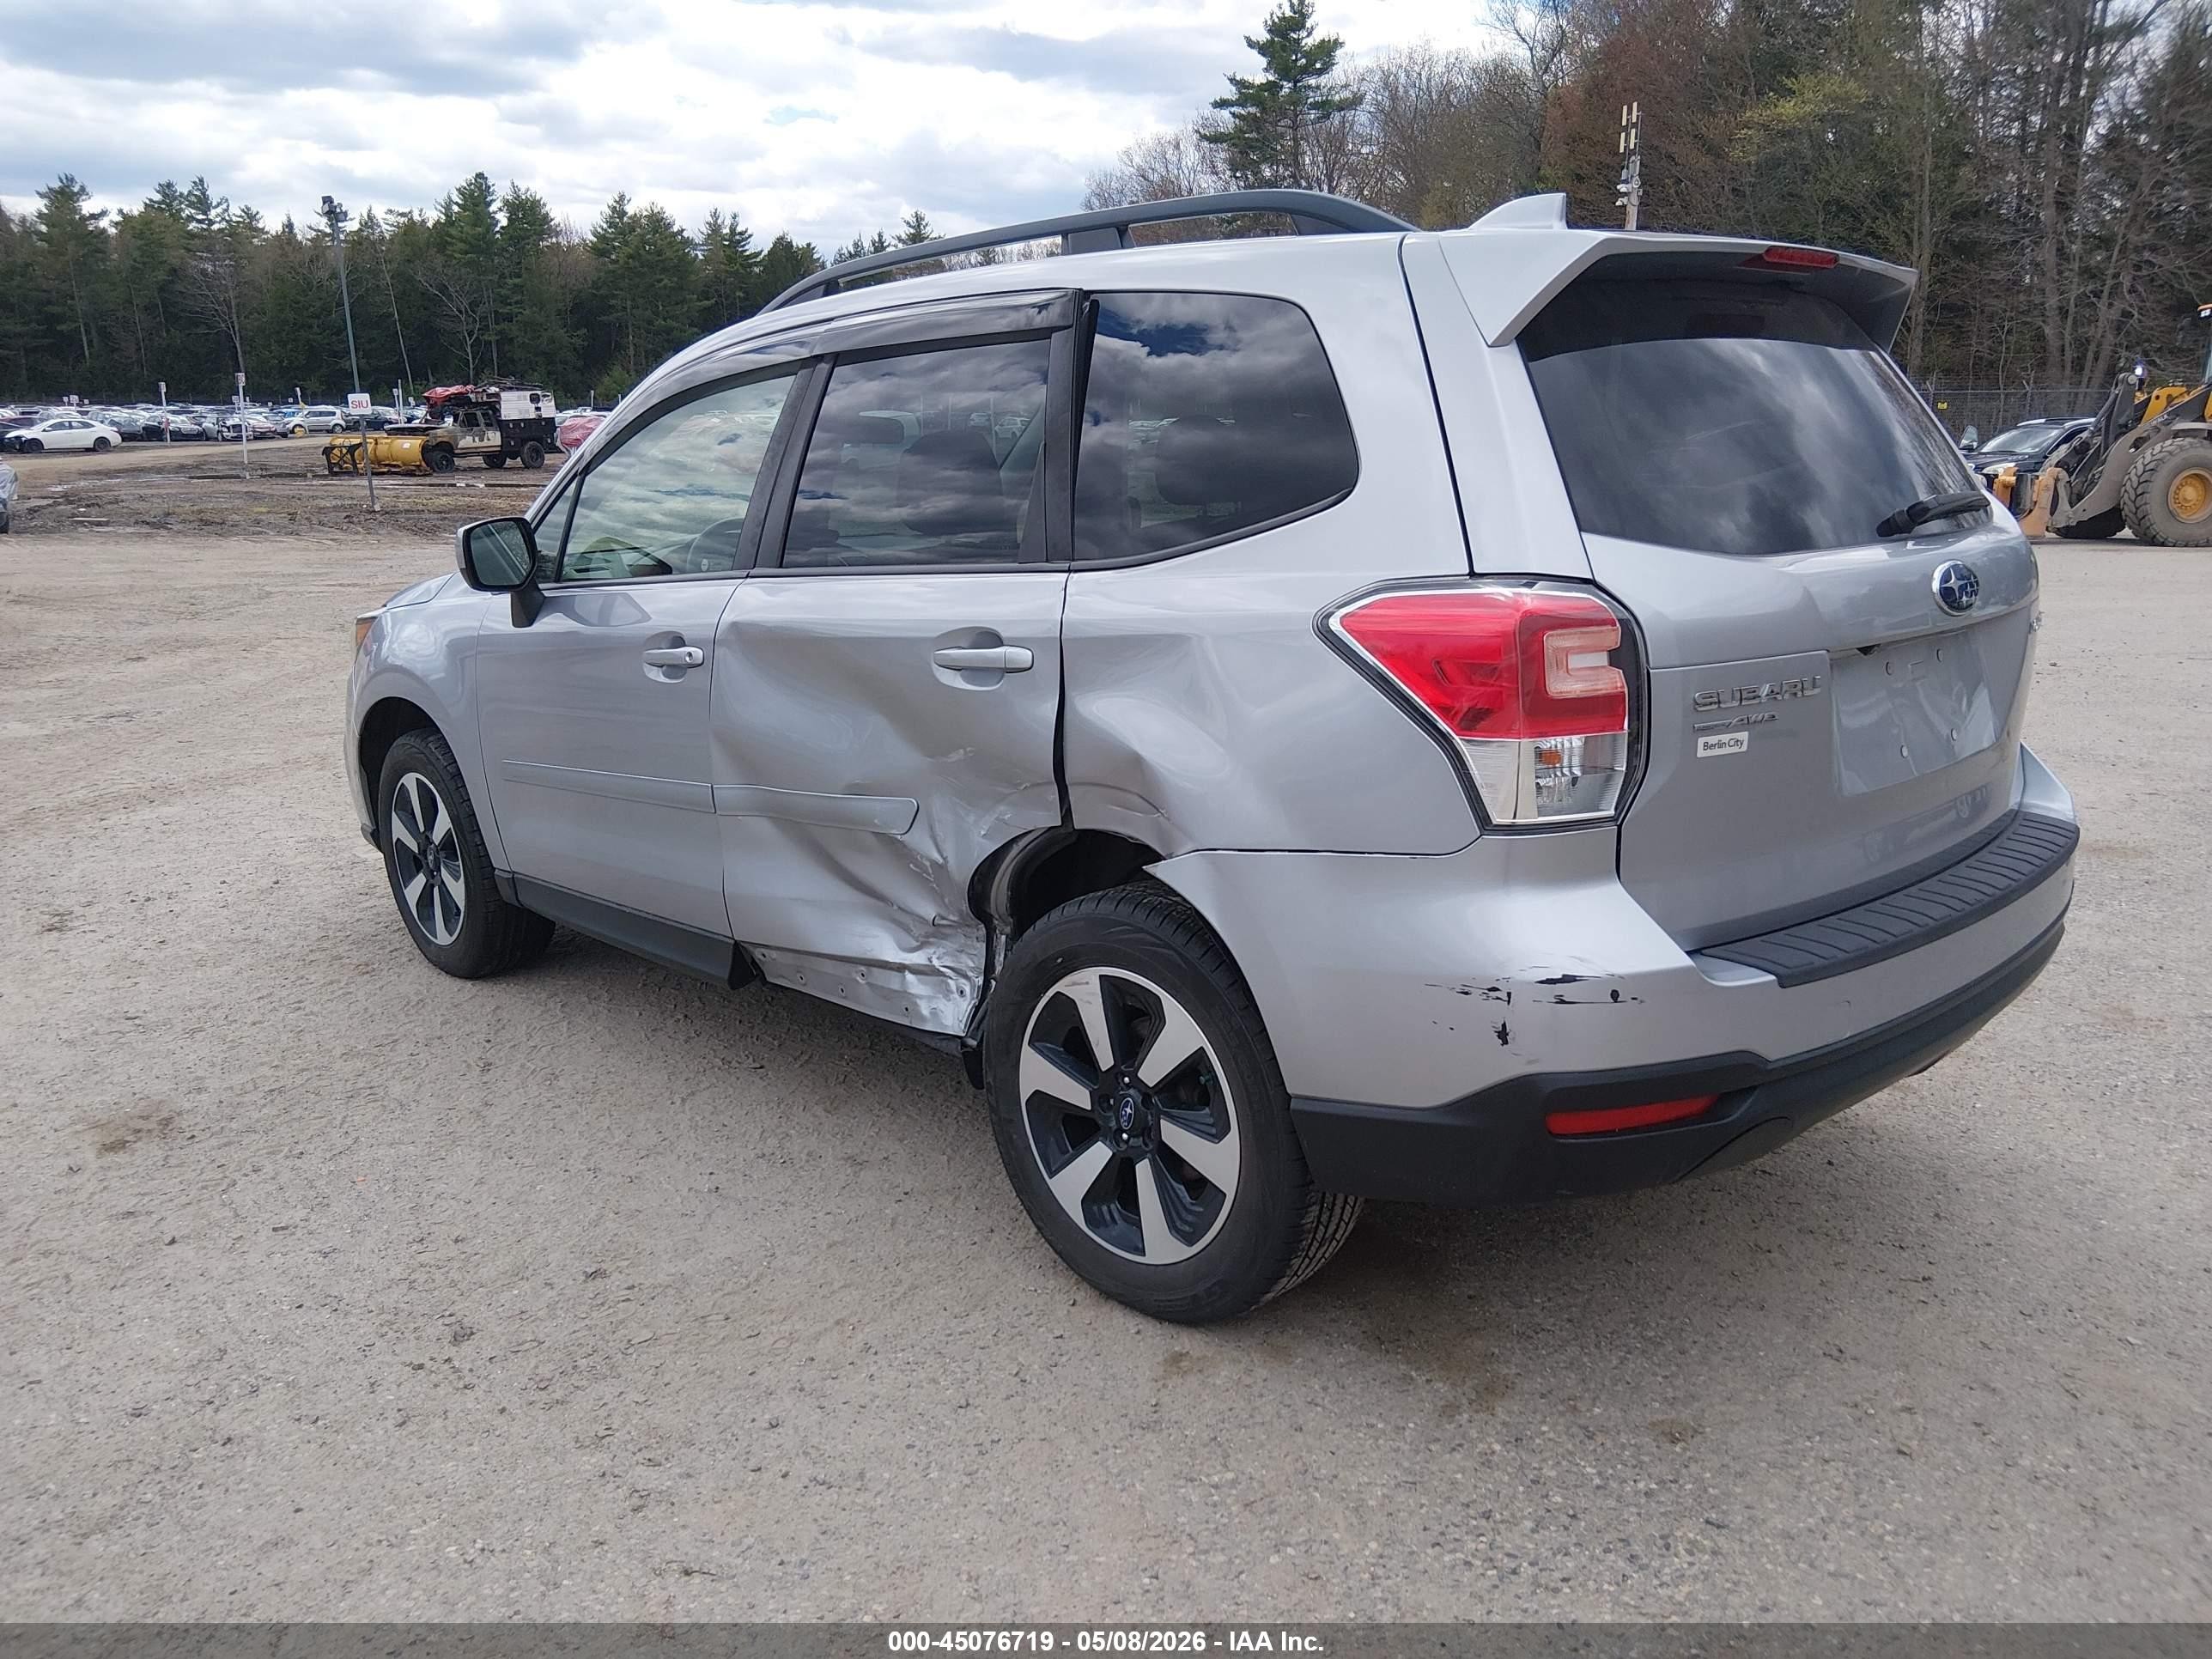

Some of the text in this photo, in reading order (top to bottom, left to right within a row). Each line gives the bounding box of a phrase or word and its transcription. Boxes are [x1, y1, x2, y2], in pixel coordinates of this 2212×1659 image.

[350, 399, 369, 410] SIU
[1693, 676, 1821, 711] SUBARU
[1727, 711, 1779, 728] AWD
[1703, 737, 1745, 751] Berlin City
